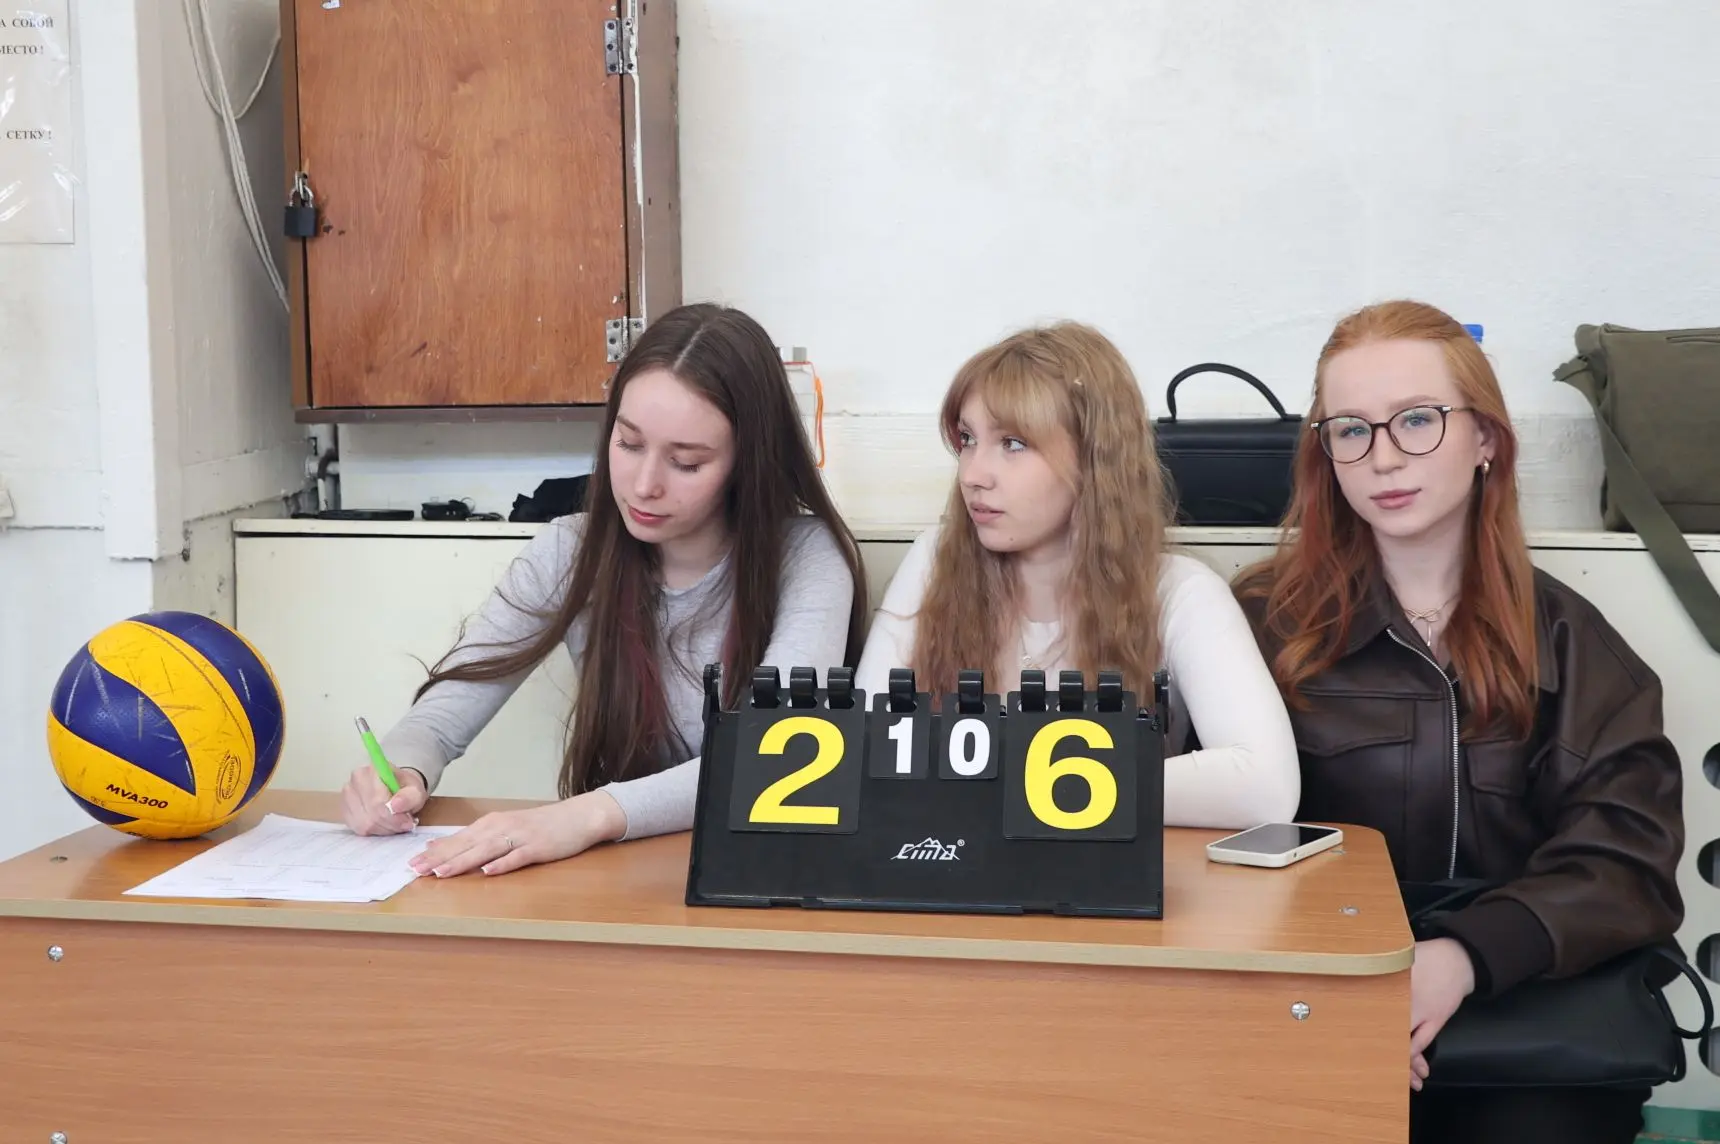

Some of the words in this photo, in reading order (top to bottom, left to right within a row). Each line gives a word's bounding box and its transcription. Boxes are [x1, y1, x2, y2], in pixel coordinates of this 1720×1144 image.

[748, 716, 845, 825] 2
[888, 716, 915, 774] 1
[948, 718, 991, 776] 0
[1024, 718, 1118, 830] 6
[106, 784, 169, 809] MVA300
